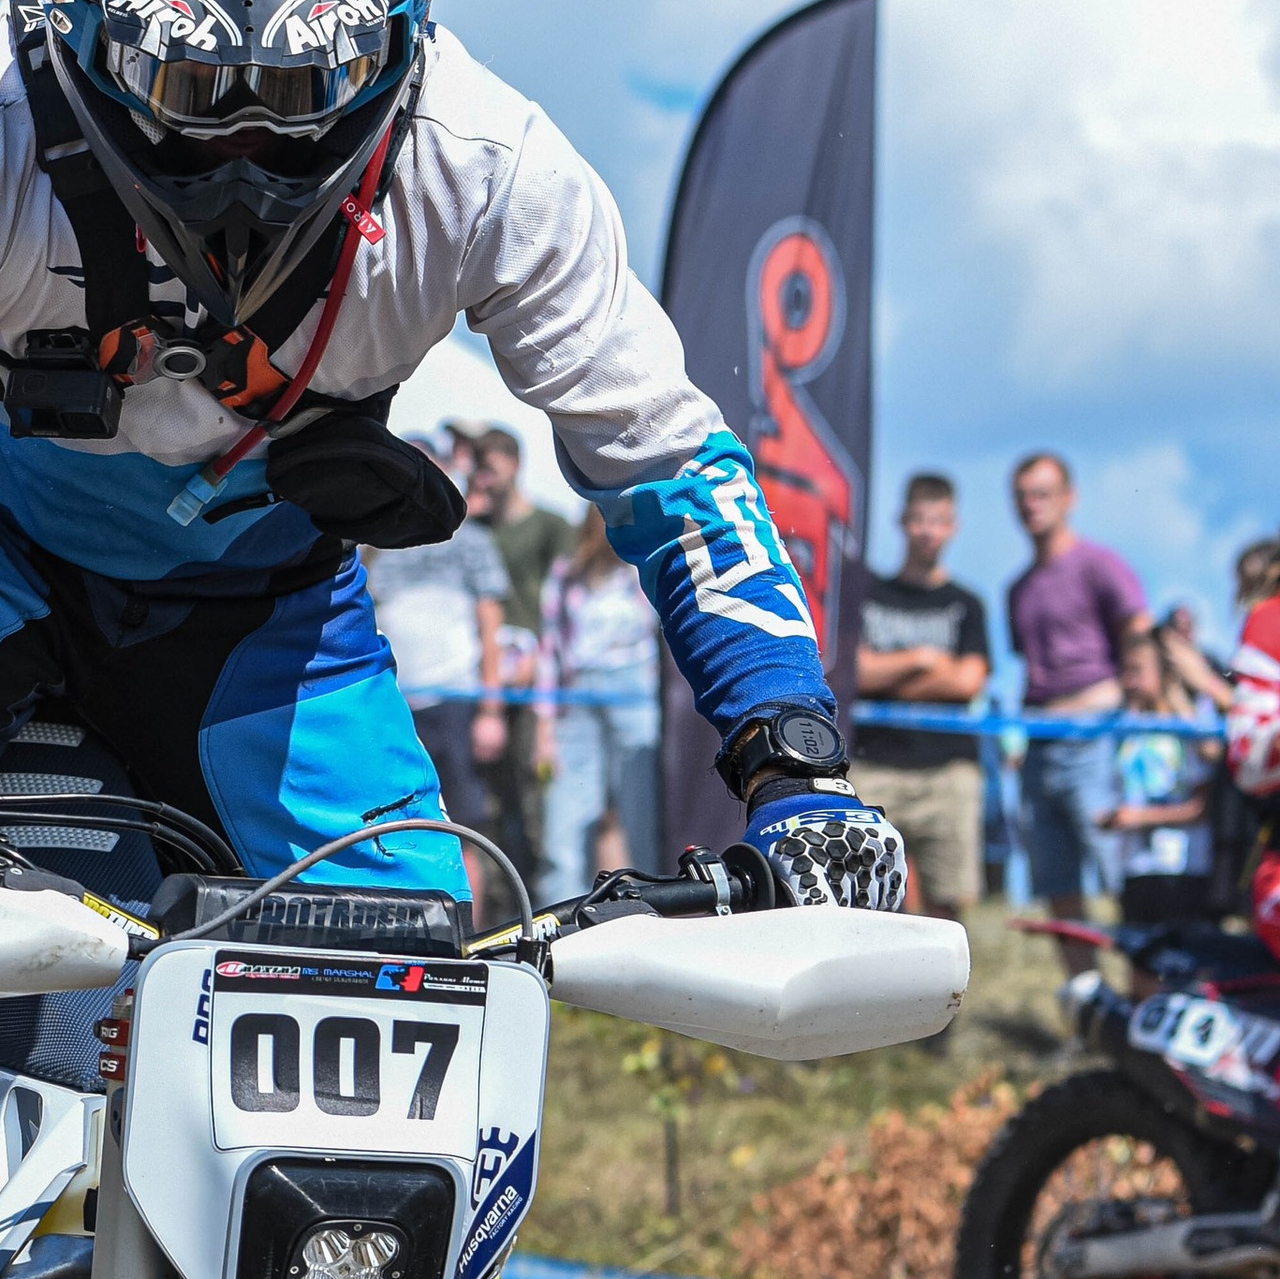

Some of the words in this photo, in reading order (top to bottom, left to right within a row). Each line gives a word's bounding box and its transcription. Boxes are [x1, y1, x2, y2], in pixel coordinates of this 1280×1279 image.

[342, 196, 377, 234] AIRO
[798, 721, 820, 756] 11:02
[230, 1012, 461, 1121] 007
[458, 1185, 519, 1274] Husqvarna
[489, 1216, 509, 1241] FACTORY
